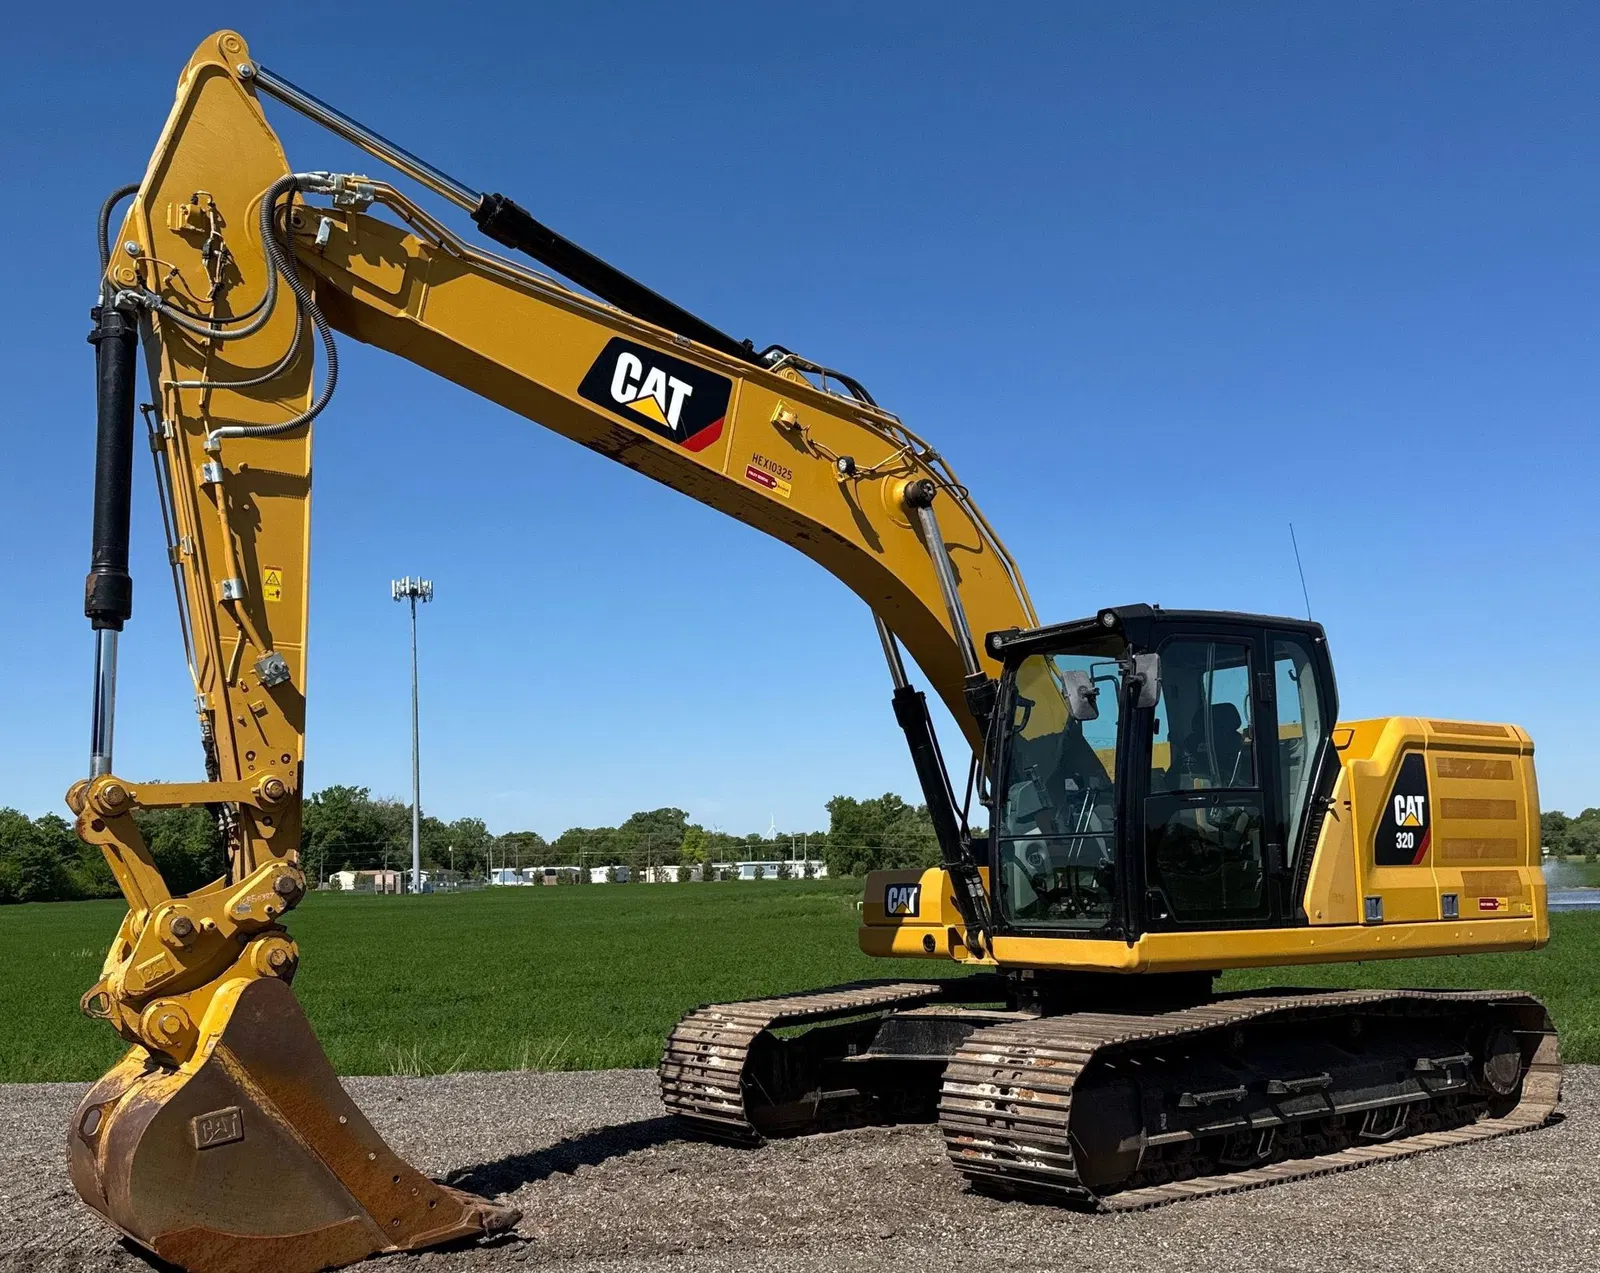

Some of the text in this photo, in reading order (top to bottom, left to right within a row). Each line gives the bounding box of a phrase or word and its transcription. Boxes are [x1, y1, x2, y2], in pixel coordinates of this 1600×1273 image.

[610, 351, 694, 431] CAT
[1393, 794, 1425, 827] CAT
[1395, 832, 1414, 849] 320
[887, 886, 918, 914] CAT
[199, 1113, 239, 1145] CAT
